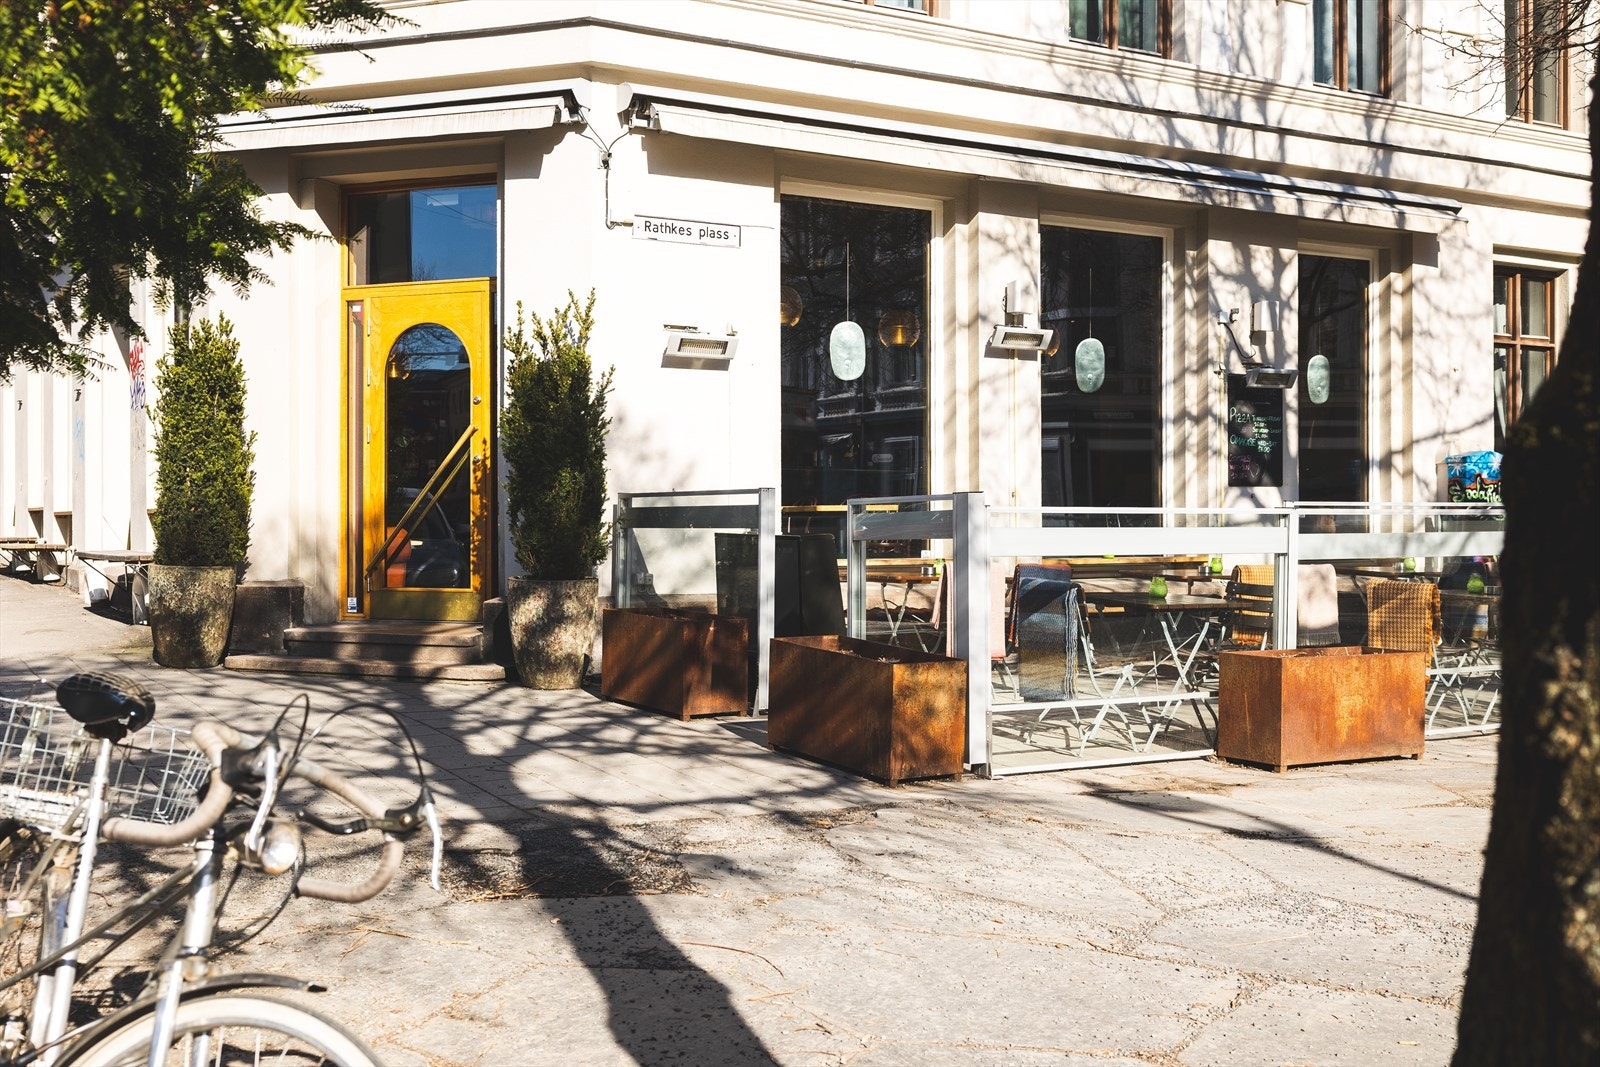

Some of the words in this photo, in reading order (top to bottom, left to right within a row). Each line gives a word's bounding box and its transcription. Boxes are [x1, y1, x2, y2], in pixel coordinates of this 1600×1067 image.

[644, 220, 692, 236] Rathkes
[699, 226, 729, 240] plass
[1230, 407, 1251, 423] PIZZA
